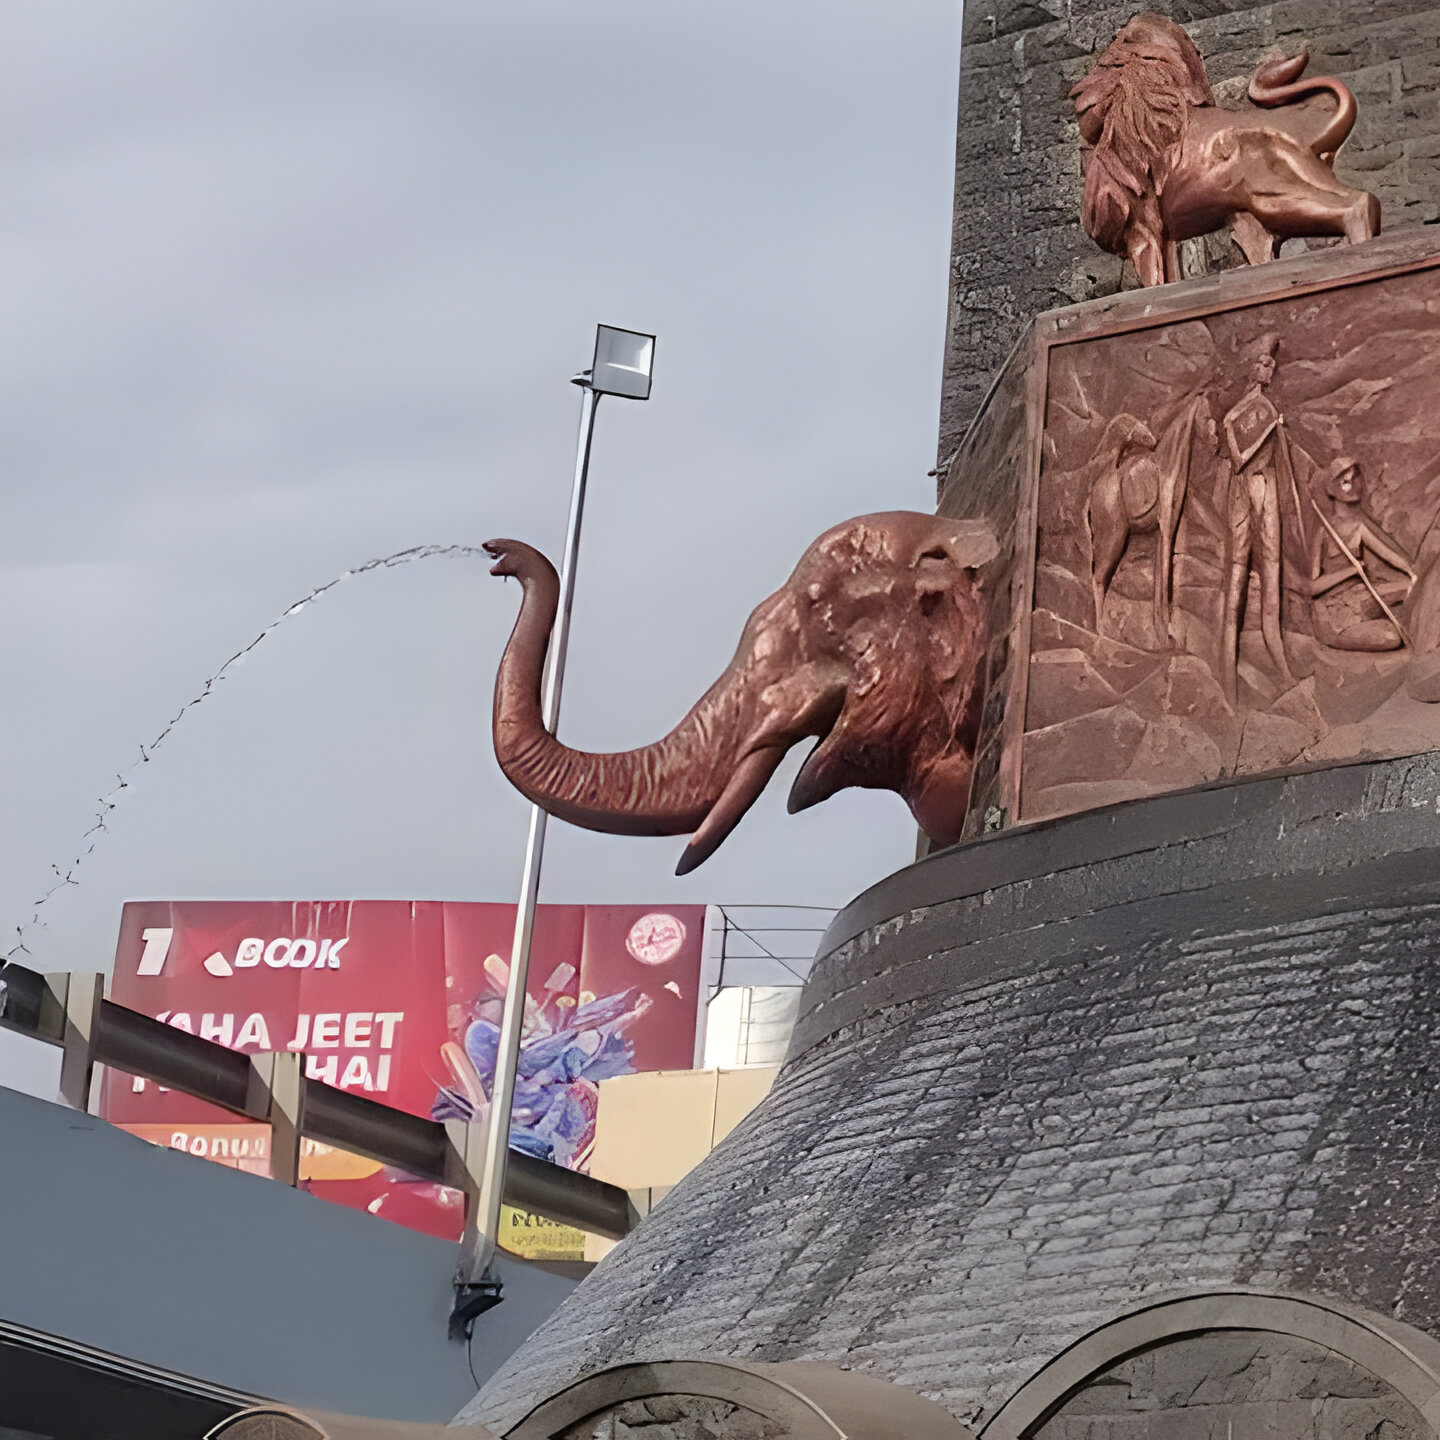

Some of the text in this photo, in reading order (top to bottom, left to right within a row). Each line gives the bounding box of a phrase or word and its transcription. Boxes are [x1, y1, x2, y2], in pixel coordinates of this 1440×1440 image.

[234, 936, 350, 970] BOOK
[155, 1010, 404, 1050] AHA JEET
